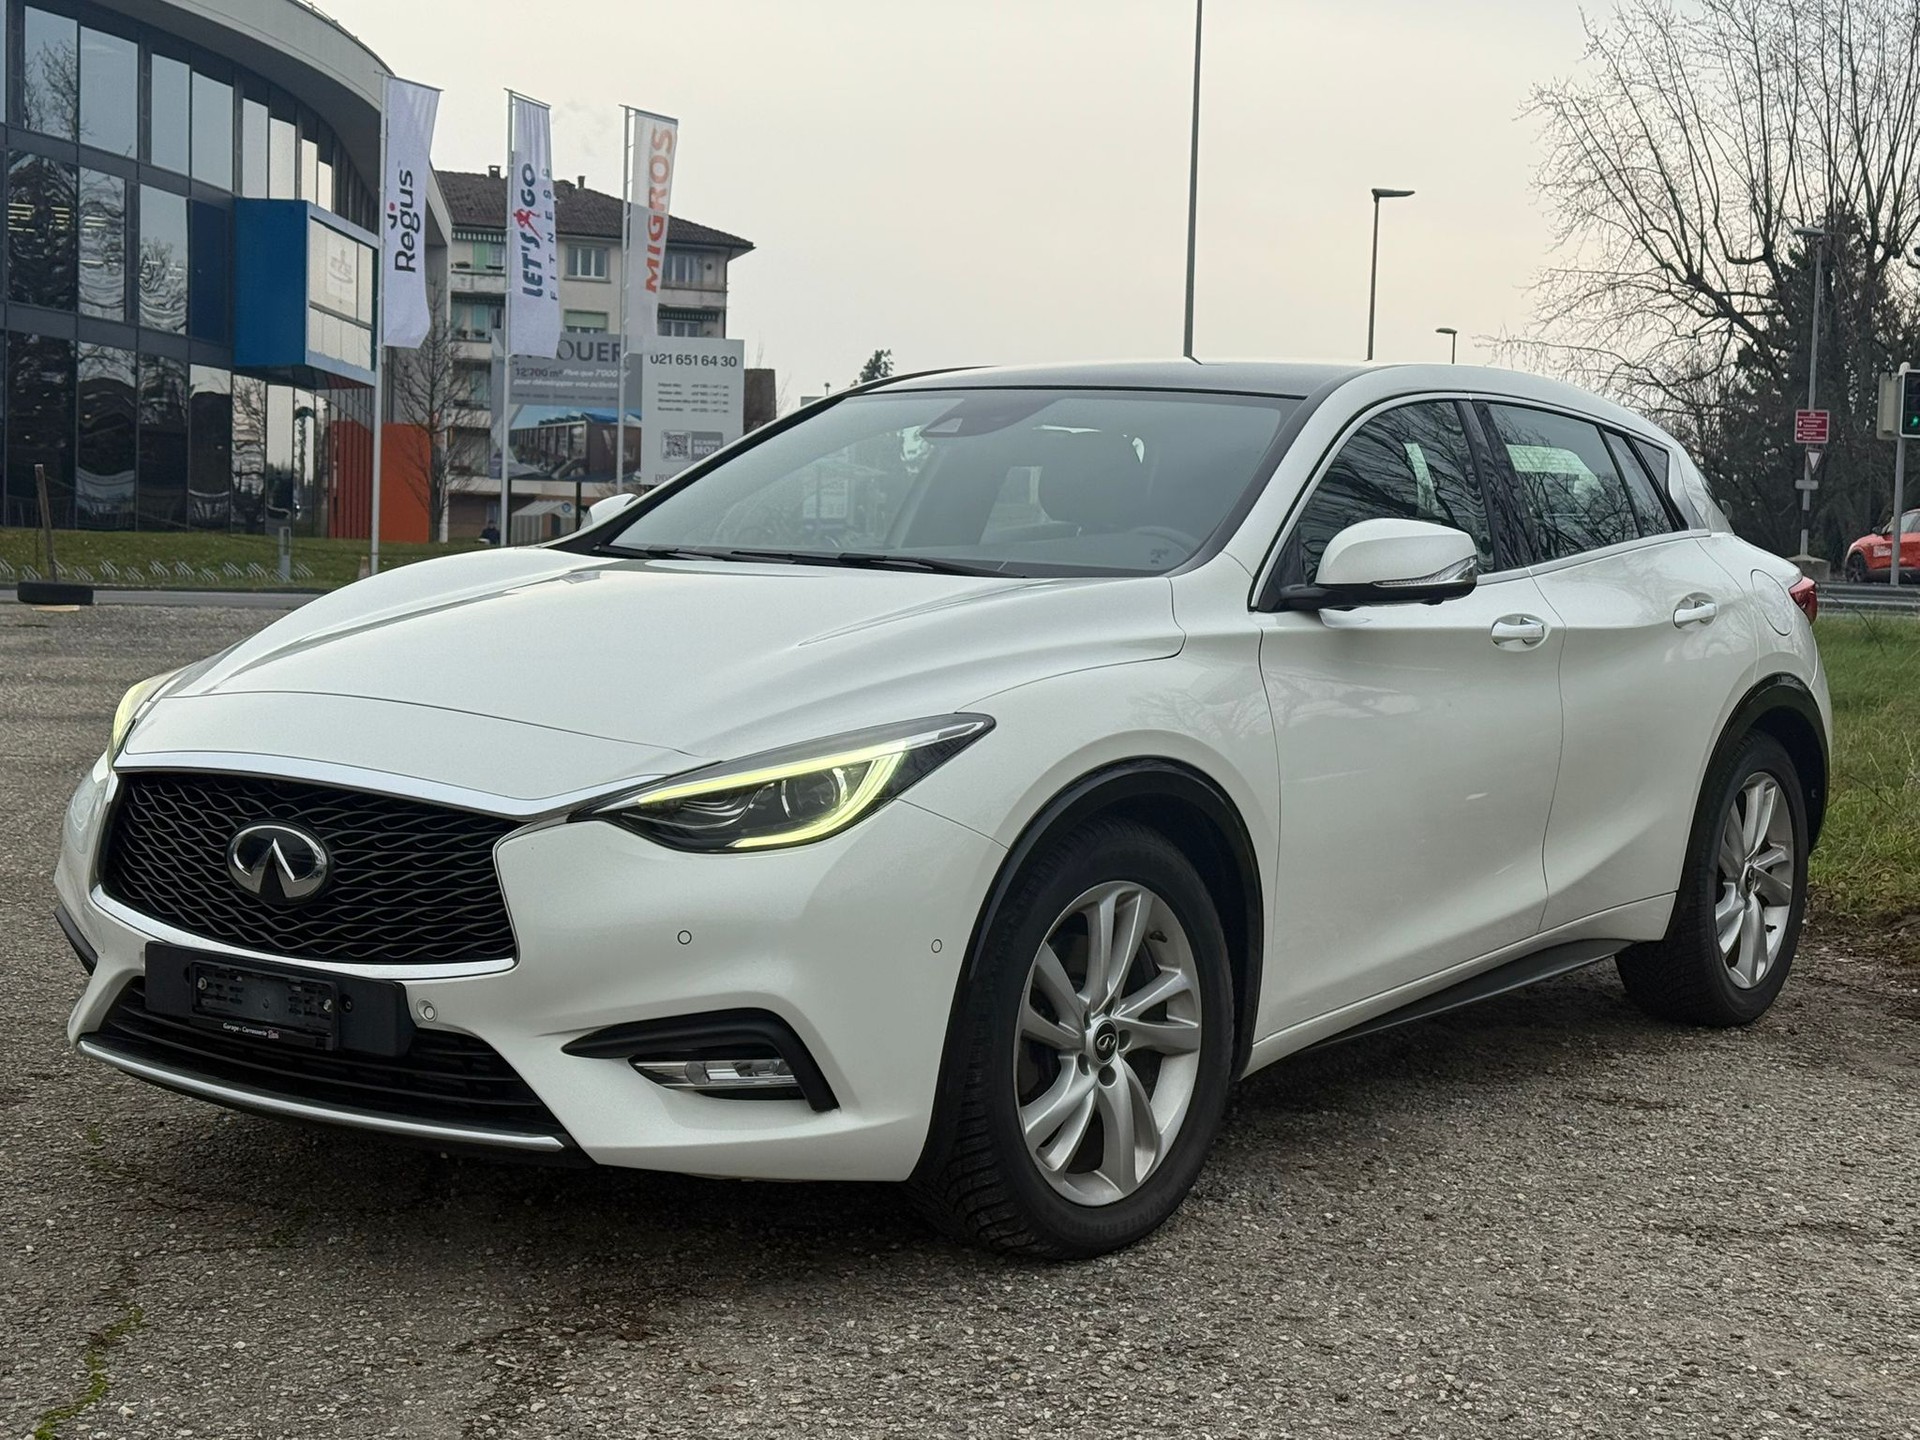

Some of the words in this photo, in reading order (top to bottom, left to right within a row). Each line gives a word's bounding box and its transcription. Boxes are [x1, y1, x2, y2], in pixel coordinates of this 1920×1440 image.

[522, 163, 536, 207] GO
[646, 125, 673, 293] MIGROS
[394, 169, 421, 272] Regus
[521, 231, 543, 298] LET'S
[650, 353, 673, 365] 021
[675, 353, 698, 366] 651
[701, 355, 718, 366] 64
[720, 355, 738, 367] 30
